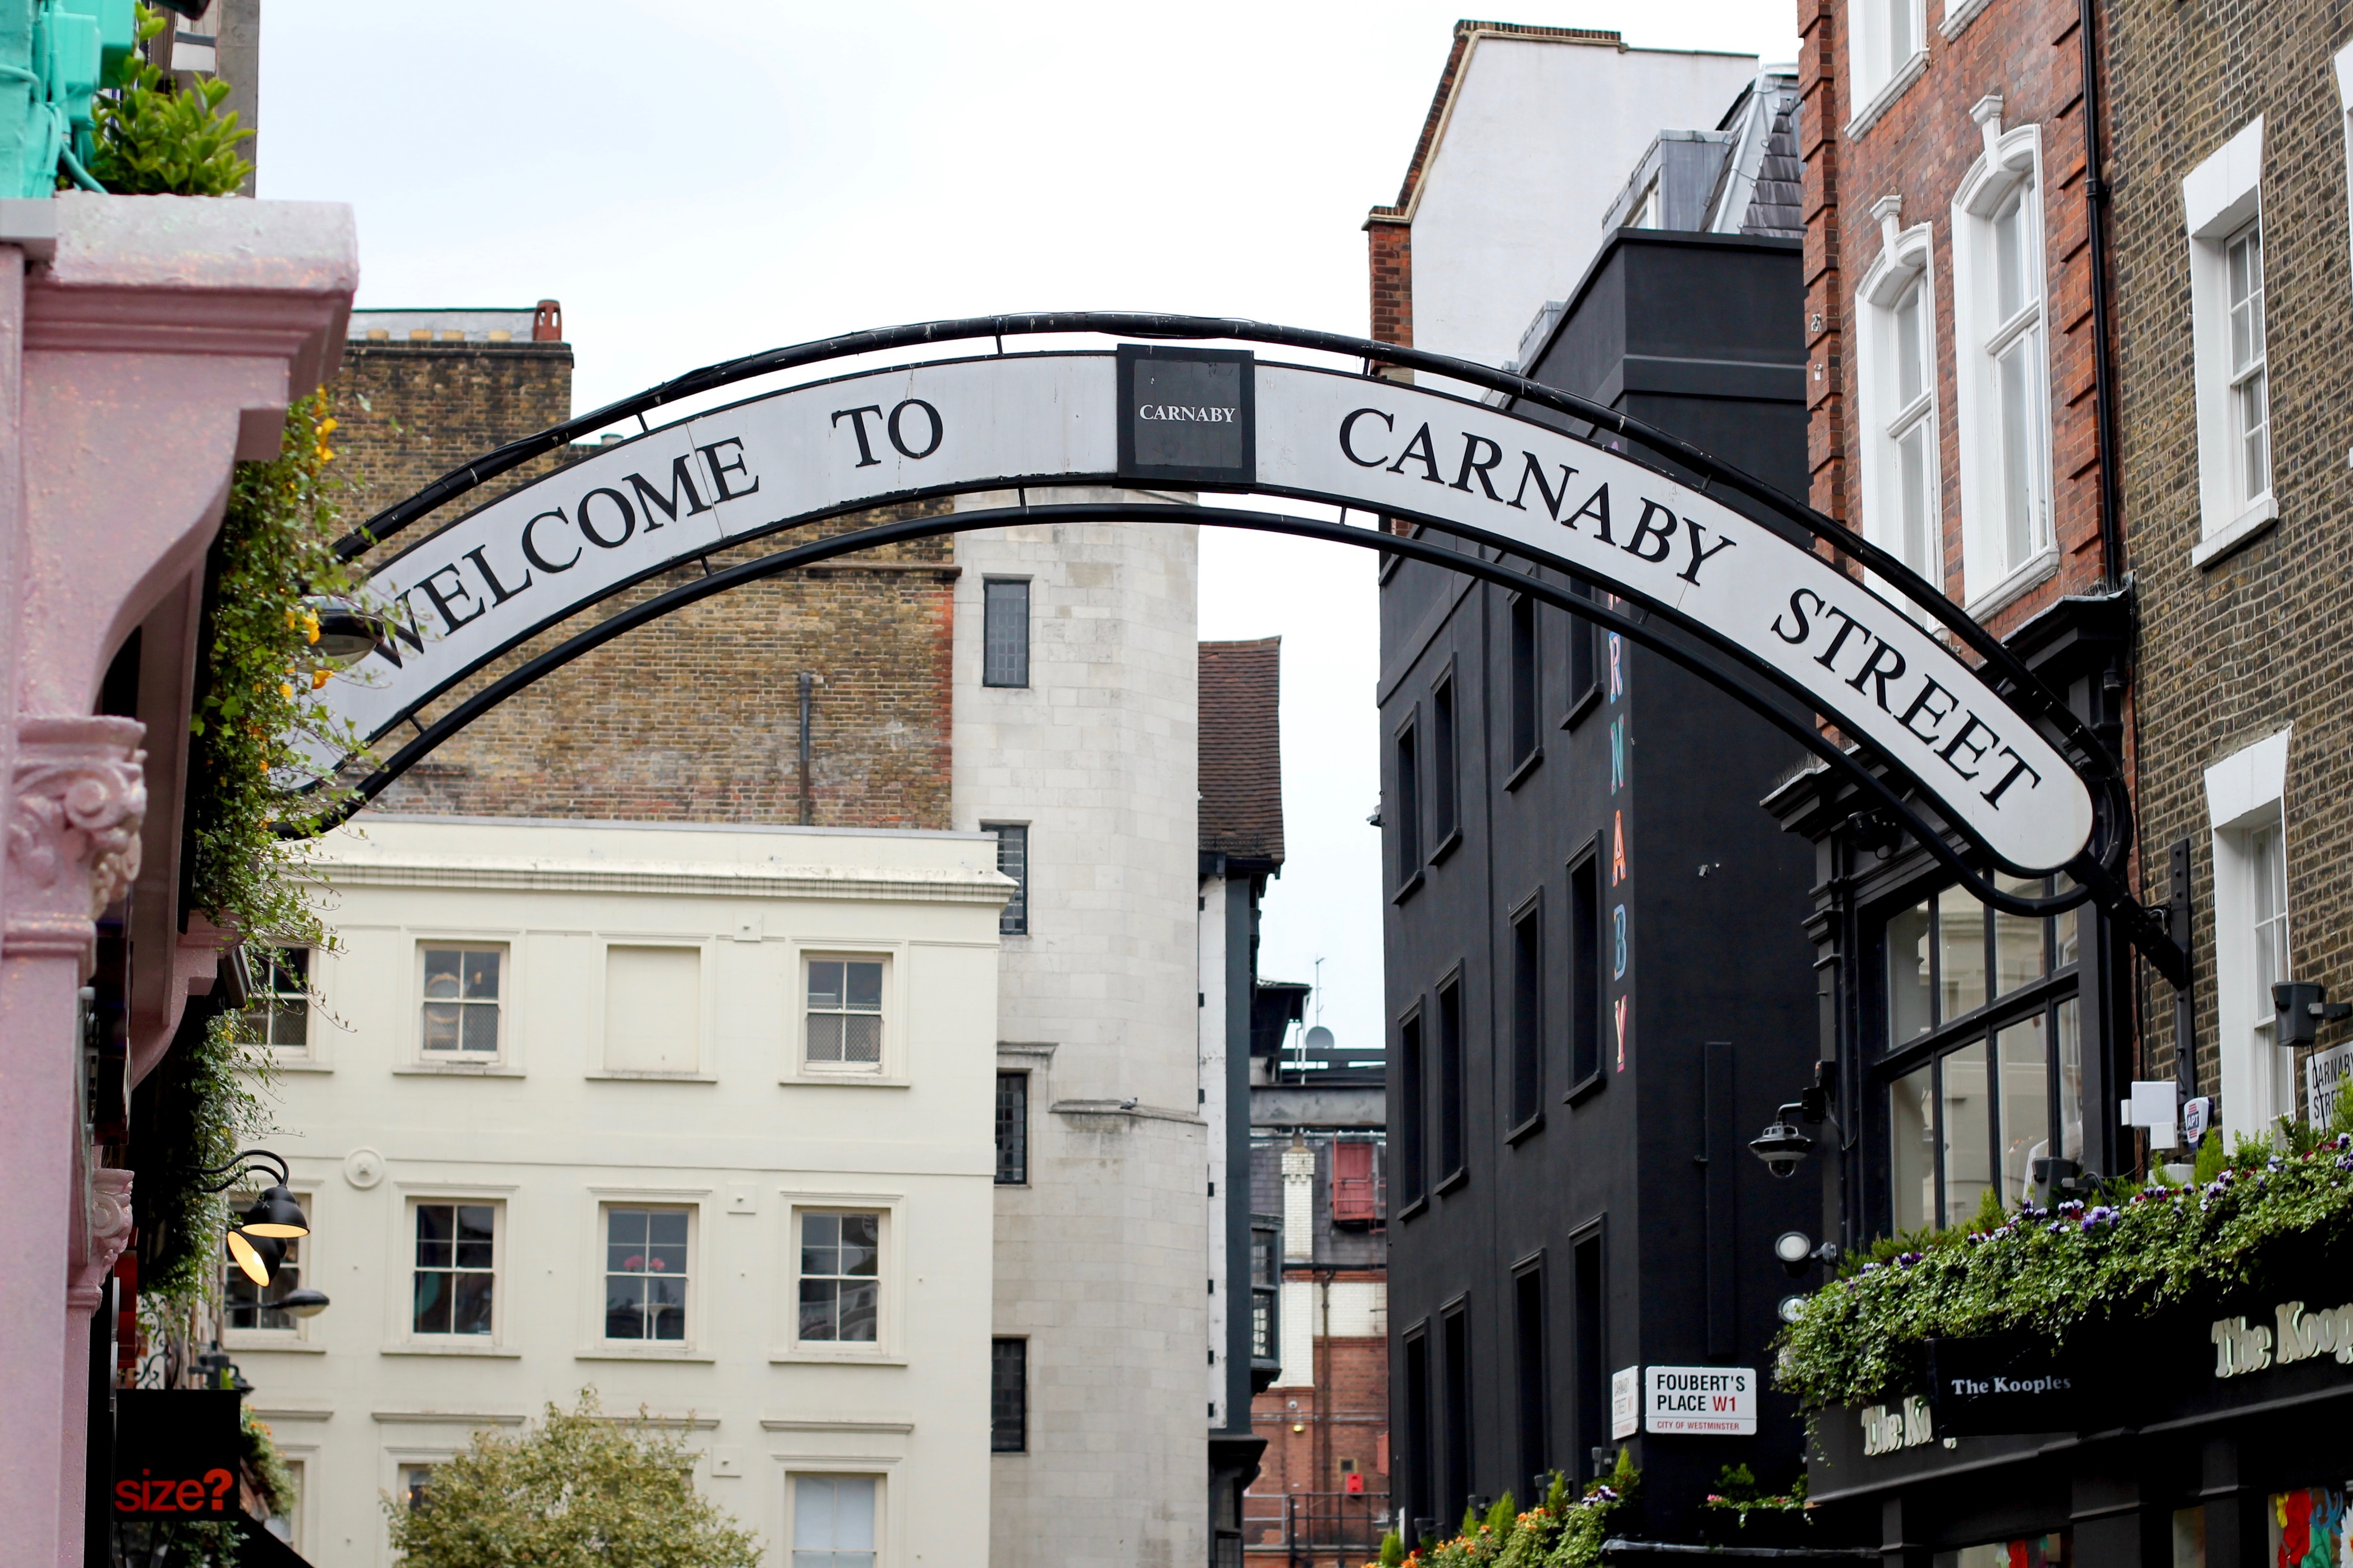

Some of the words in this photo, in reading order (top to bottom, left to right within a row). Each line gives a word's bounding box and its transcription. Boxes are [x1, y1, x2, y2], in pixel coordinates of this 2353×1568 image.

[1140, 404, 1236, 422] CARNABY
[373, 436, 759, 669] WELCOME
[831, 398, 942, 468] TO
[1339, 407, 1736, 586] CARNABY
[1771, 588, 2041, 810] STREET
[2188, 1114, 2199, 1129] APT
[2211, 1316, 2272, 1378] The
[1657, 1374, 1745, 1392] FOUBERT'S
[1951, 1379, 1988, 1395] The
[1994, 1375, 2071, 1394] Kooples
[1657, 1395, 1706, 1412] PLACE
[1712, 1396, 1736, 1412] W1
[1657, 1421, 1673, 1429] CITY
[1676, 1421, 1685, 1429] OF
[1688, 1422, 1739, 1430] WESTMINSTER
[1861, 1404, 1903, 1456] The
[114, 1468, 234, 1512] size?
